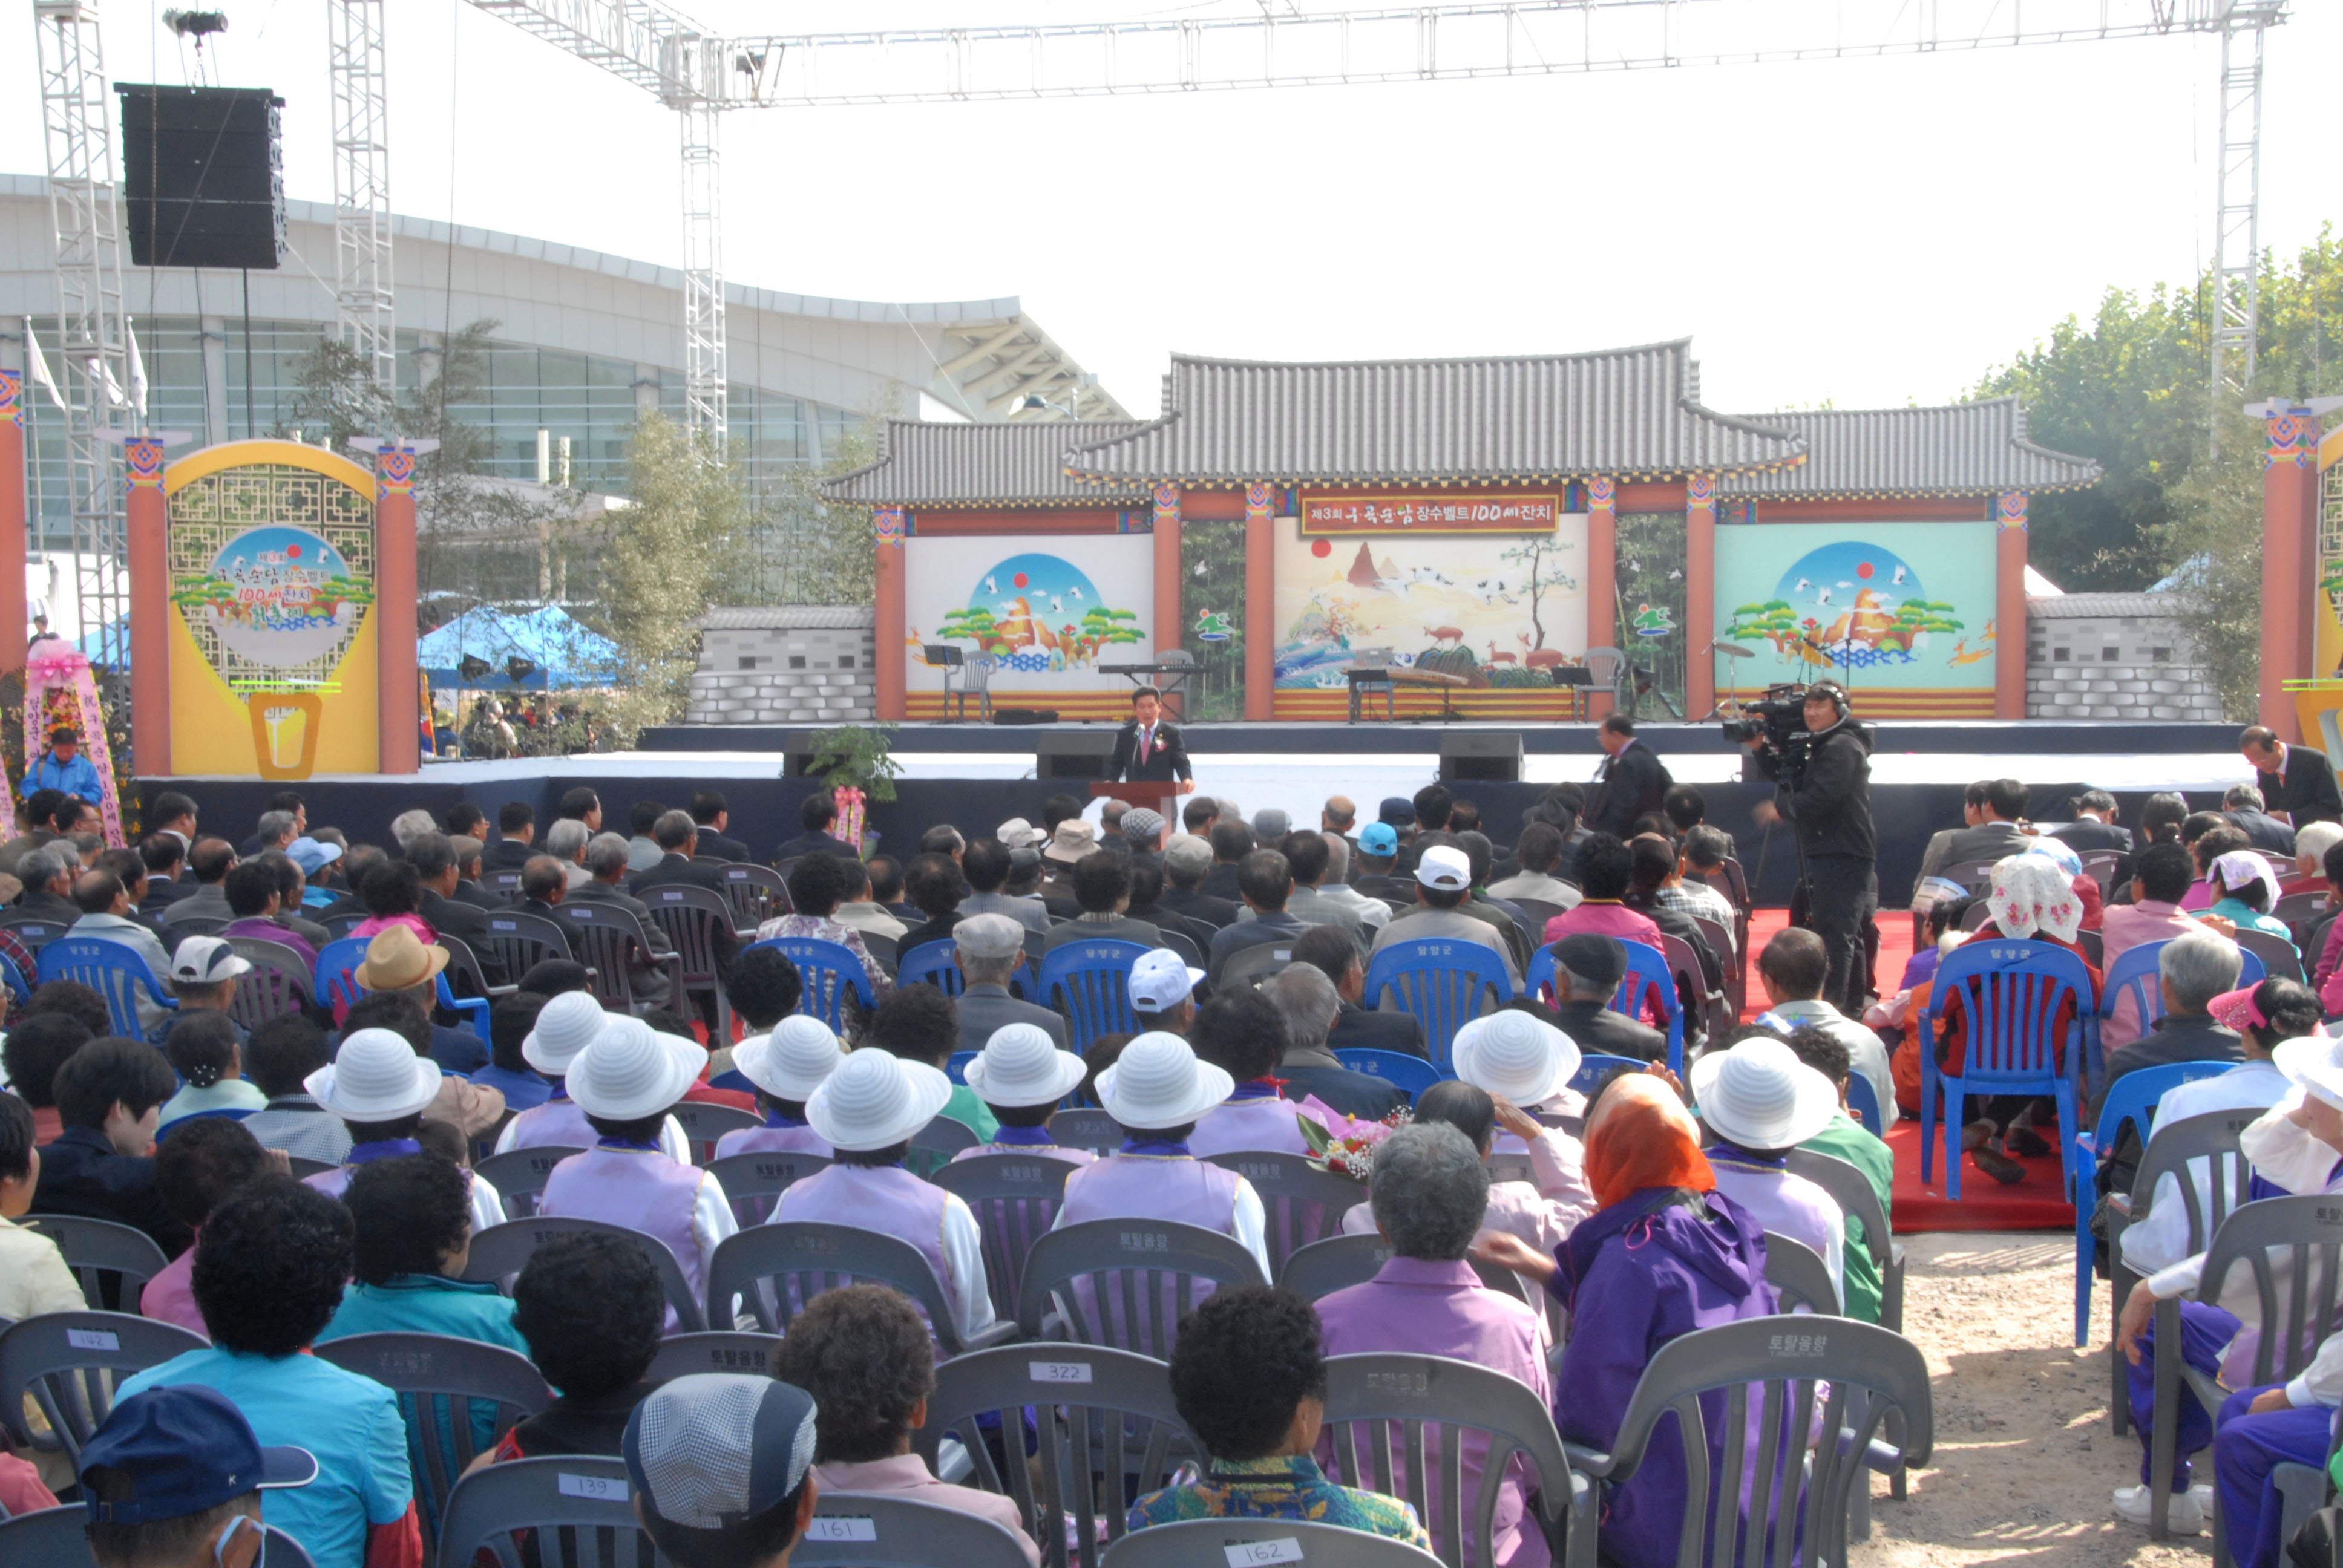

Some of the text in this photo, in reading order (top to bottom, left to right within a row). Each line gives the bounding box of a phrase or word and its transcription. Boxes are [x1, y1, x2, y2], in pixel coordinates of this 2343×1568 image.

[1311, 507, 1342, 520] 제3회
[1417, 505, 1470, 521] 장수벨트
[1521, 505, 1550, 521] 잔치
[258, 550, 287, 563] 제3회
[238, 587, 310, 603] 100세 잔치
[1418, 945, 1452, 956] 담양군
[1990, 948, 2031, 959] 담양군
[1768, 1334, 1827, 1352] 토탈음향
[711, 1350, 766, 1366] 토탈음향
[1049, 1365, 1080, 1379] 322
[229, 1474, 237, 1486] K
[579, 1478, 607, 1494] 139
[821, 1521, 853, 1537] 161
[1245, 1543, 1283, 1563] 162
